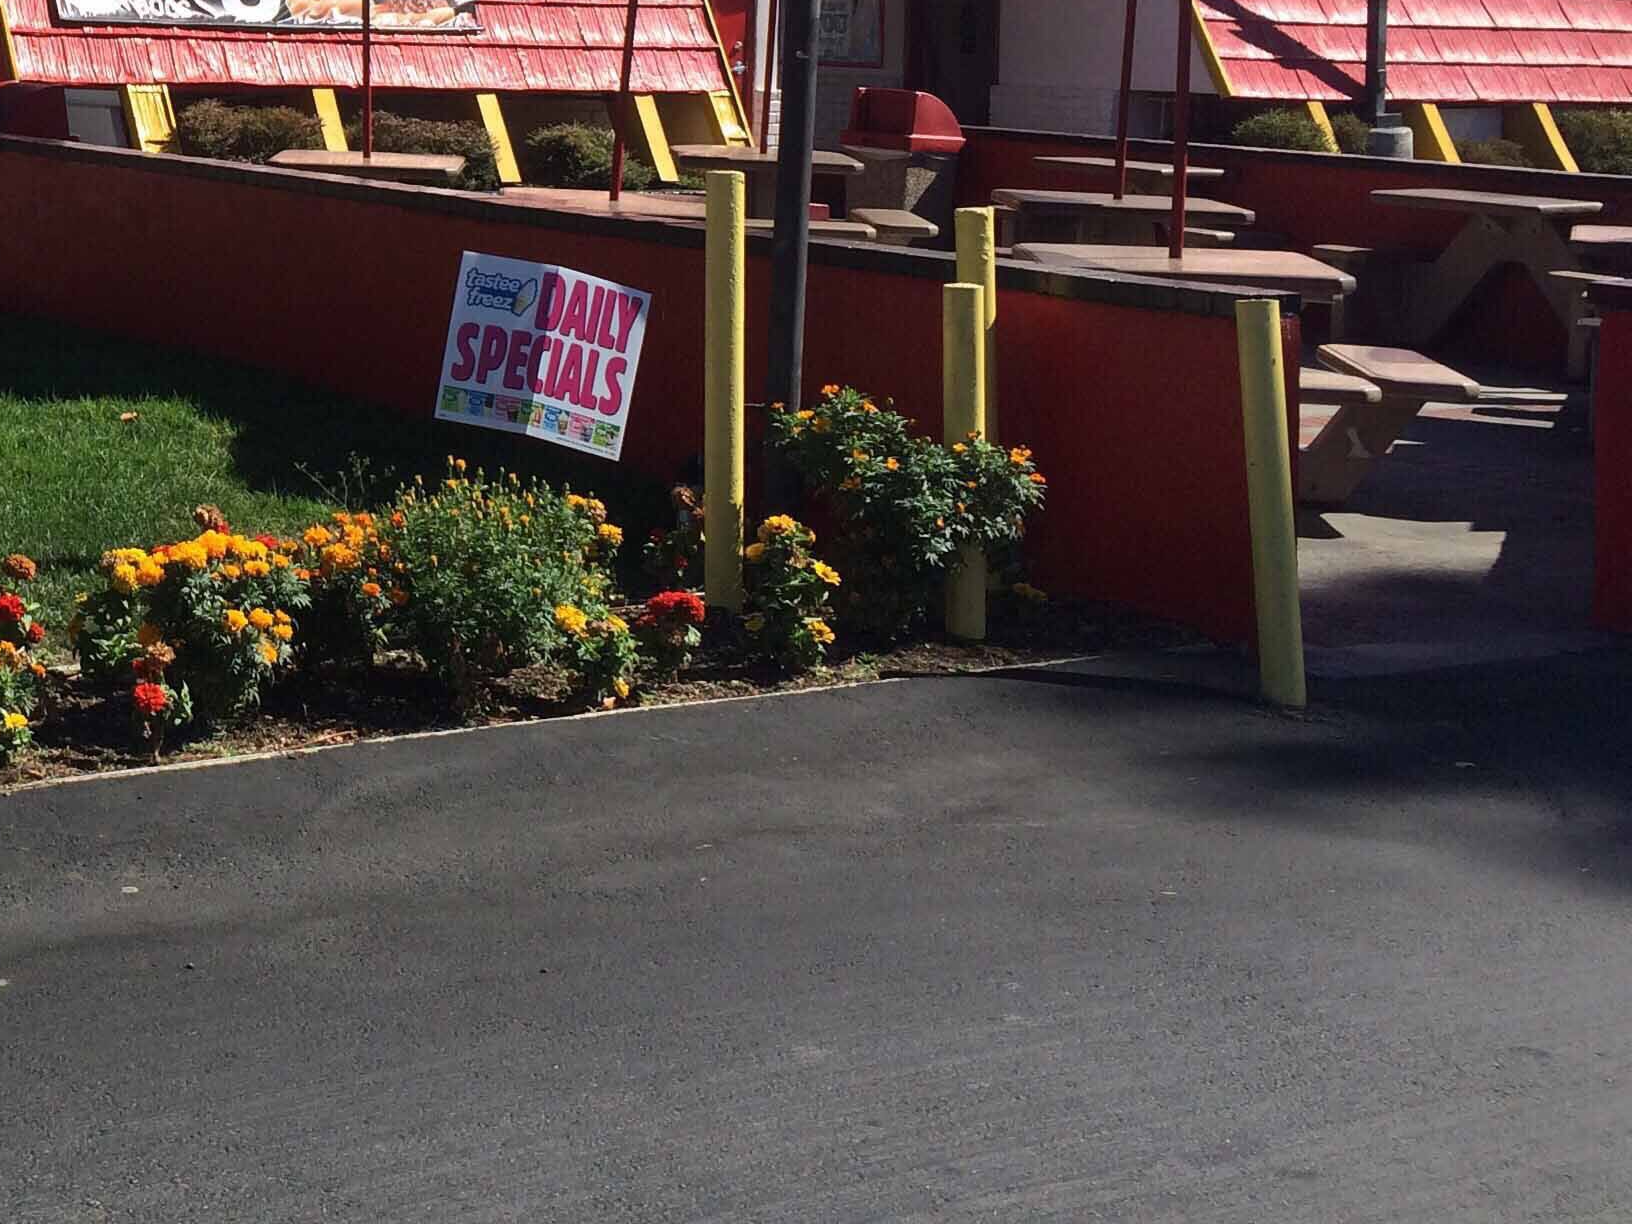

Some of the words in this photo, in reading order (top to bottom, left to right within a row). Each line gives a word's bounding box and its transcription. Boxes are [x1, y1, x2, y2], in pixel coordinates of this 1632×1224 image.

[466, 268, 521, 293] tastee
[469, 286, 513, 310] freez
[535, 272, 643, 354] DAILY
[450, 322, 628, 417] SPECIALS
